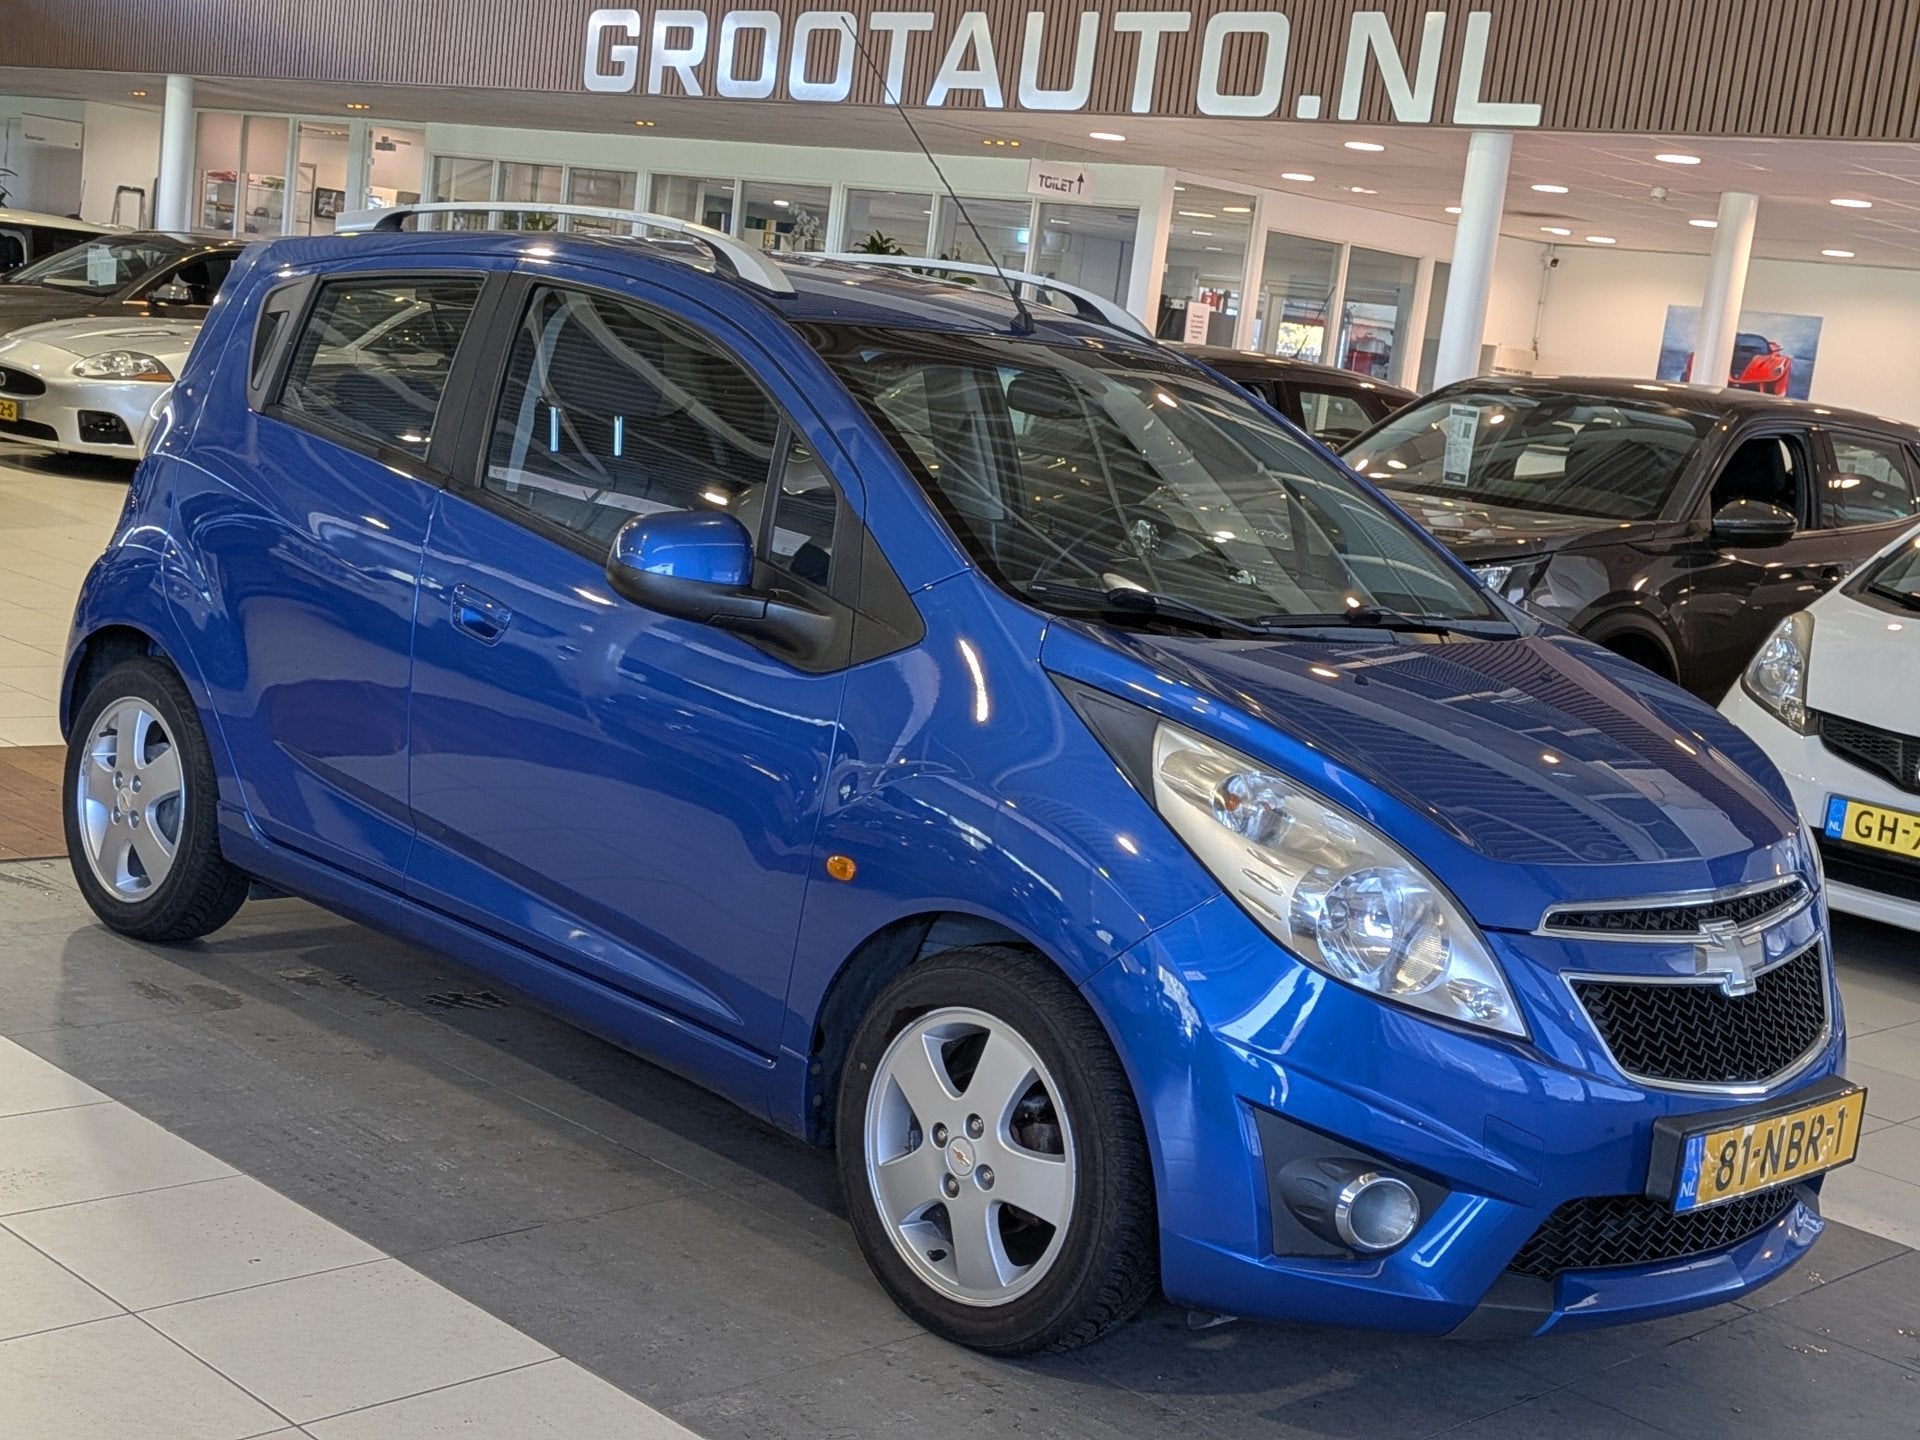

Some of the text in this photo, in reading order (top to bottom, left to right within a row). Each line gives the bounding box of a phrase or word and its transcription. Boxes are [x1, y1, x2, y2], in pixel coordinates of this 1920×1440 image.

[584, 9, 1542, 126] GROOTAUTO.NL
[1039, 174, 1074, 193] TOILET
[1828, 820, 1841, 831] NL
[1715, 1105, 1847, 1192] 81-NBR-1
[1680, 1181, 1695, 1198] NL
